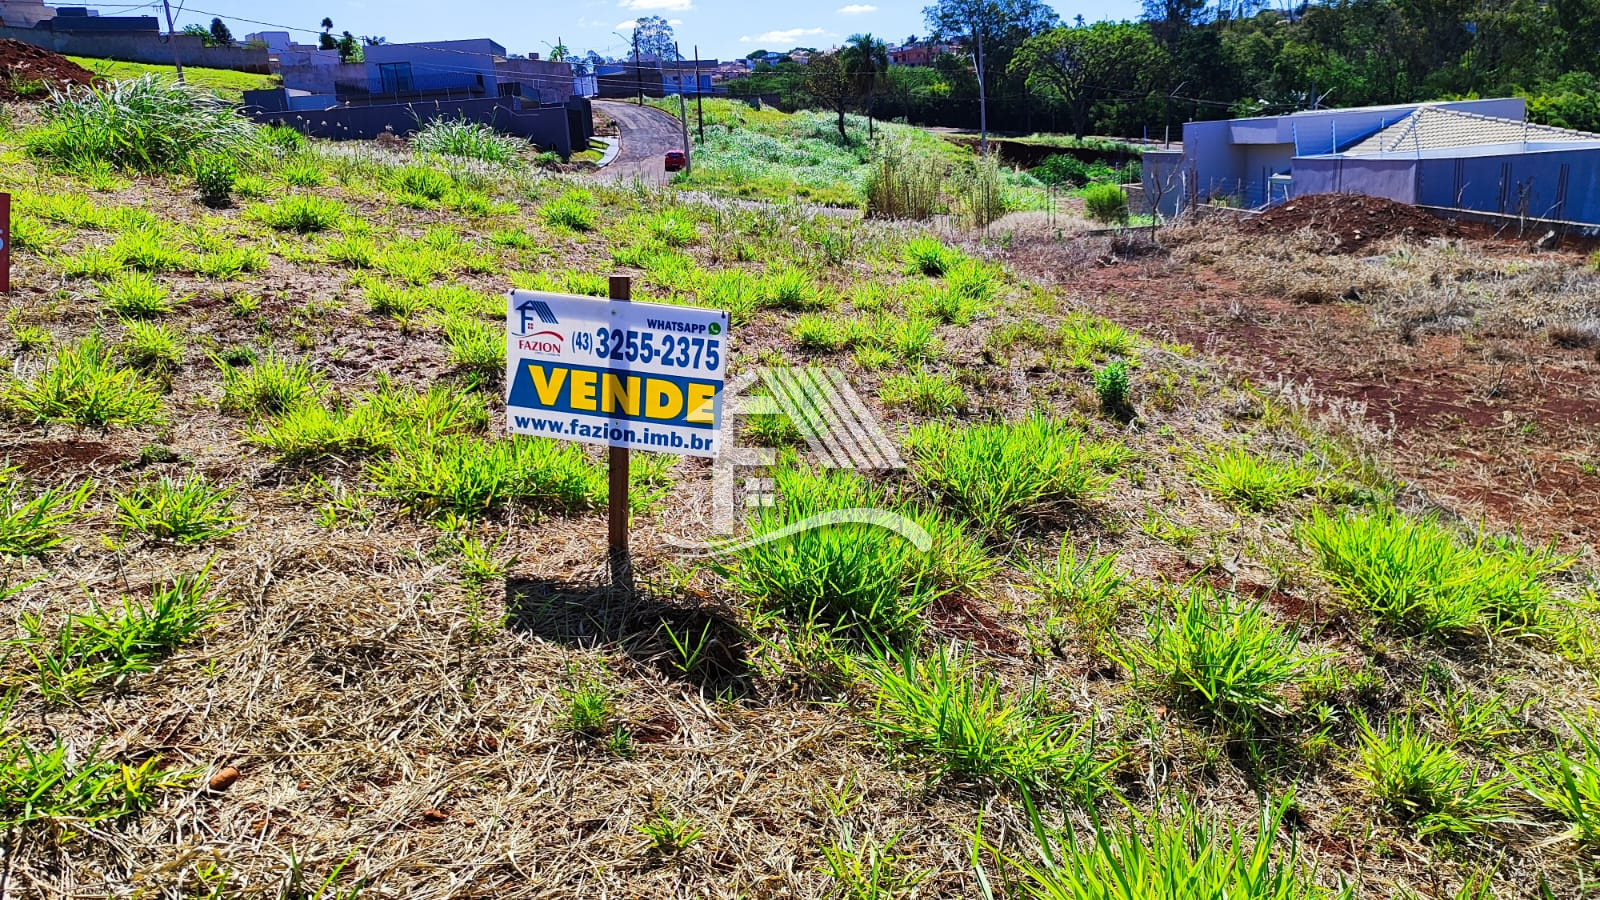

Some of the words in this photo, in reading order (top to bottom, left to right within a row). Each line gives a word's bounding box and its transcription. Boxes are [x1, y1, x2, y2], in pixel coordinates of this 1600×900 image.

[647, 318, 706, 334] WHATSAPP
[518, 339, 561, 354] FAZION
[571, 331, 593, 355] (43)
[595, 327, 720, 371] 3255-2375
[528, 364, 716, 424] VENDE
[514, 415, 714, 451] www.fazion.imb.br
